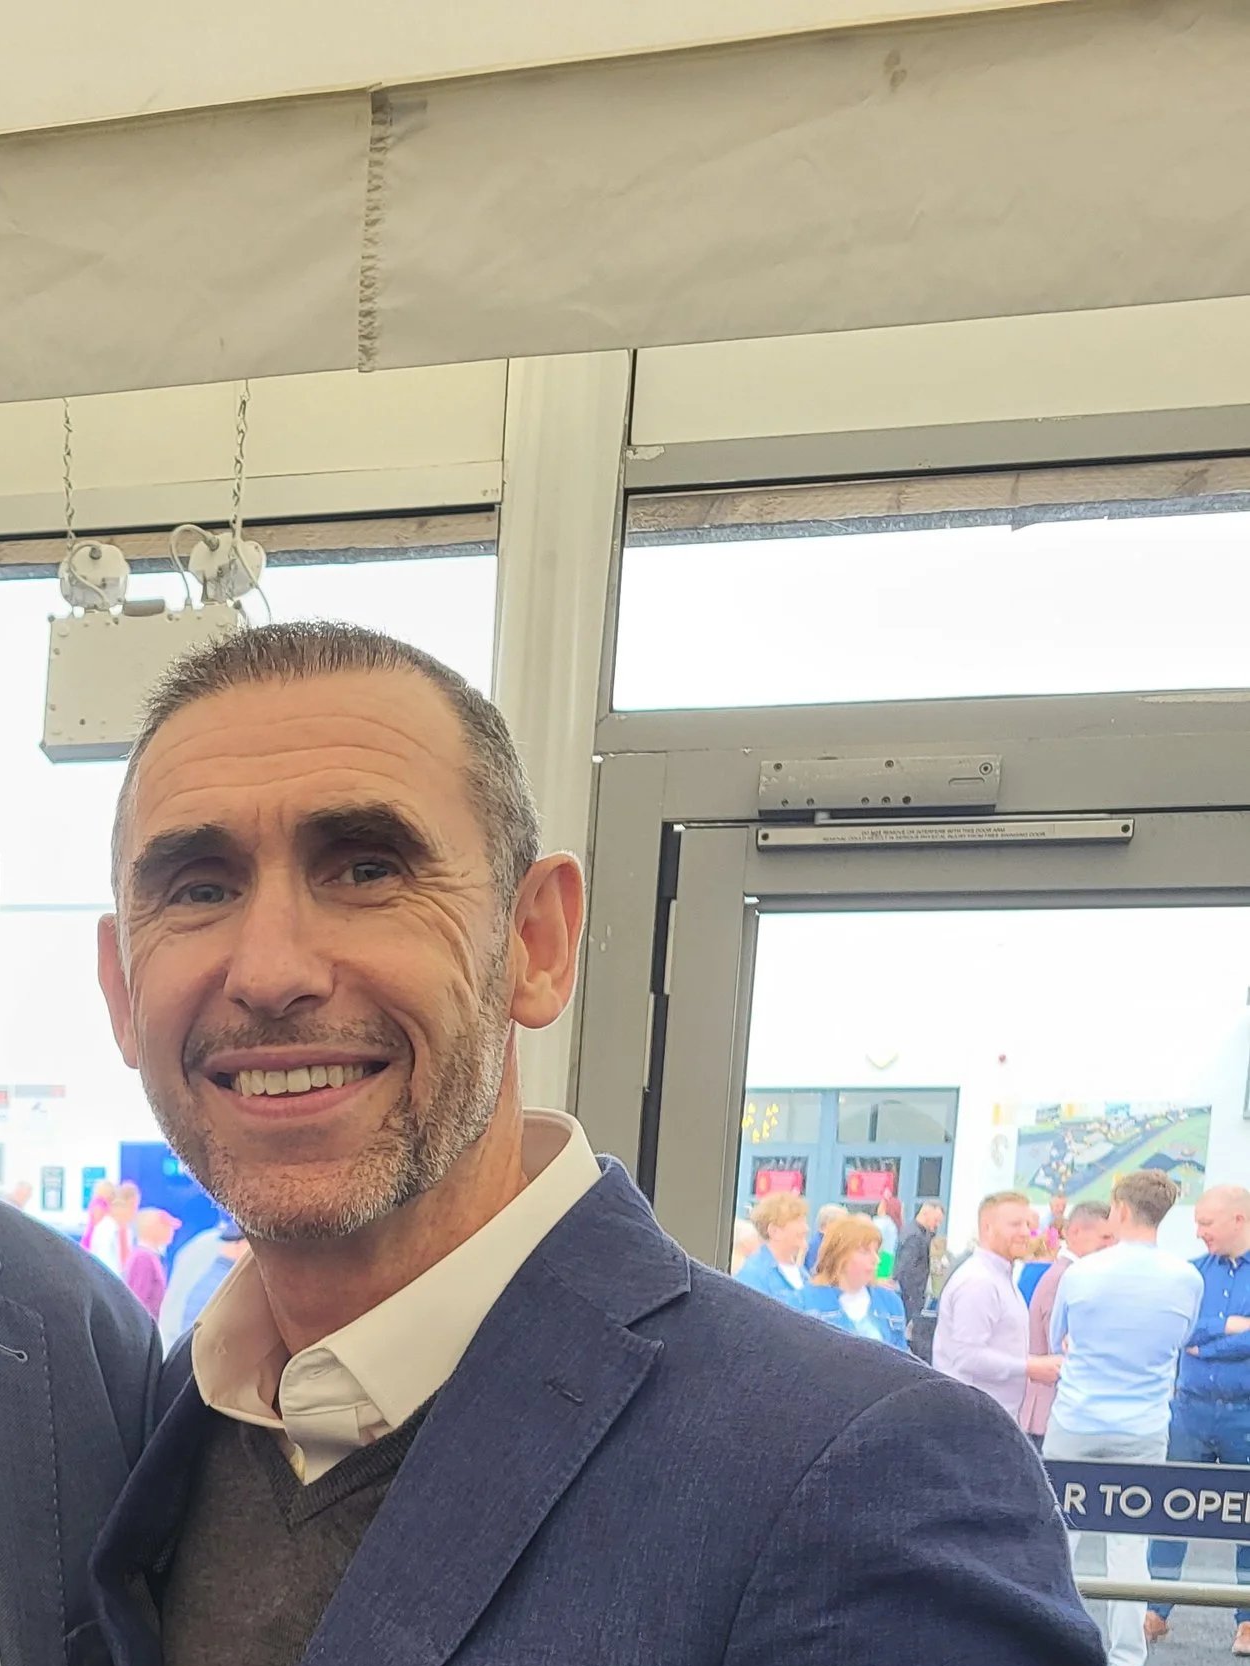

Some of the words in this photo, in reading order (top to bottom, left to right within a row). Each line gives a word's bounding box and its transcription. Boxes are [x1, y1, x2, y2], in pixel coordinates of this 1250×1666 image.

[1063, 1482, 1087, 1516] R
[1099, 1484, 1152, 1519] TO
[1163, 1487, 1250, 1524] OPE
